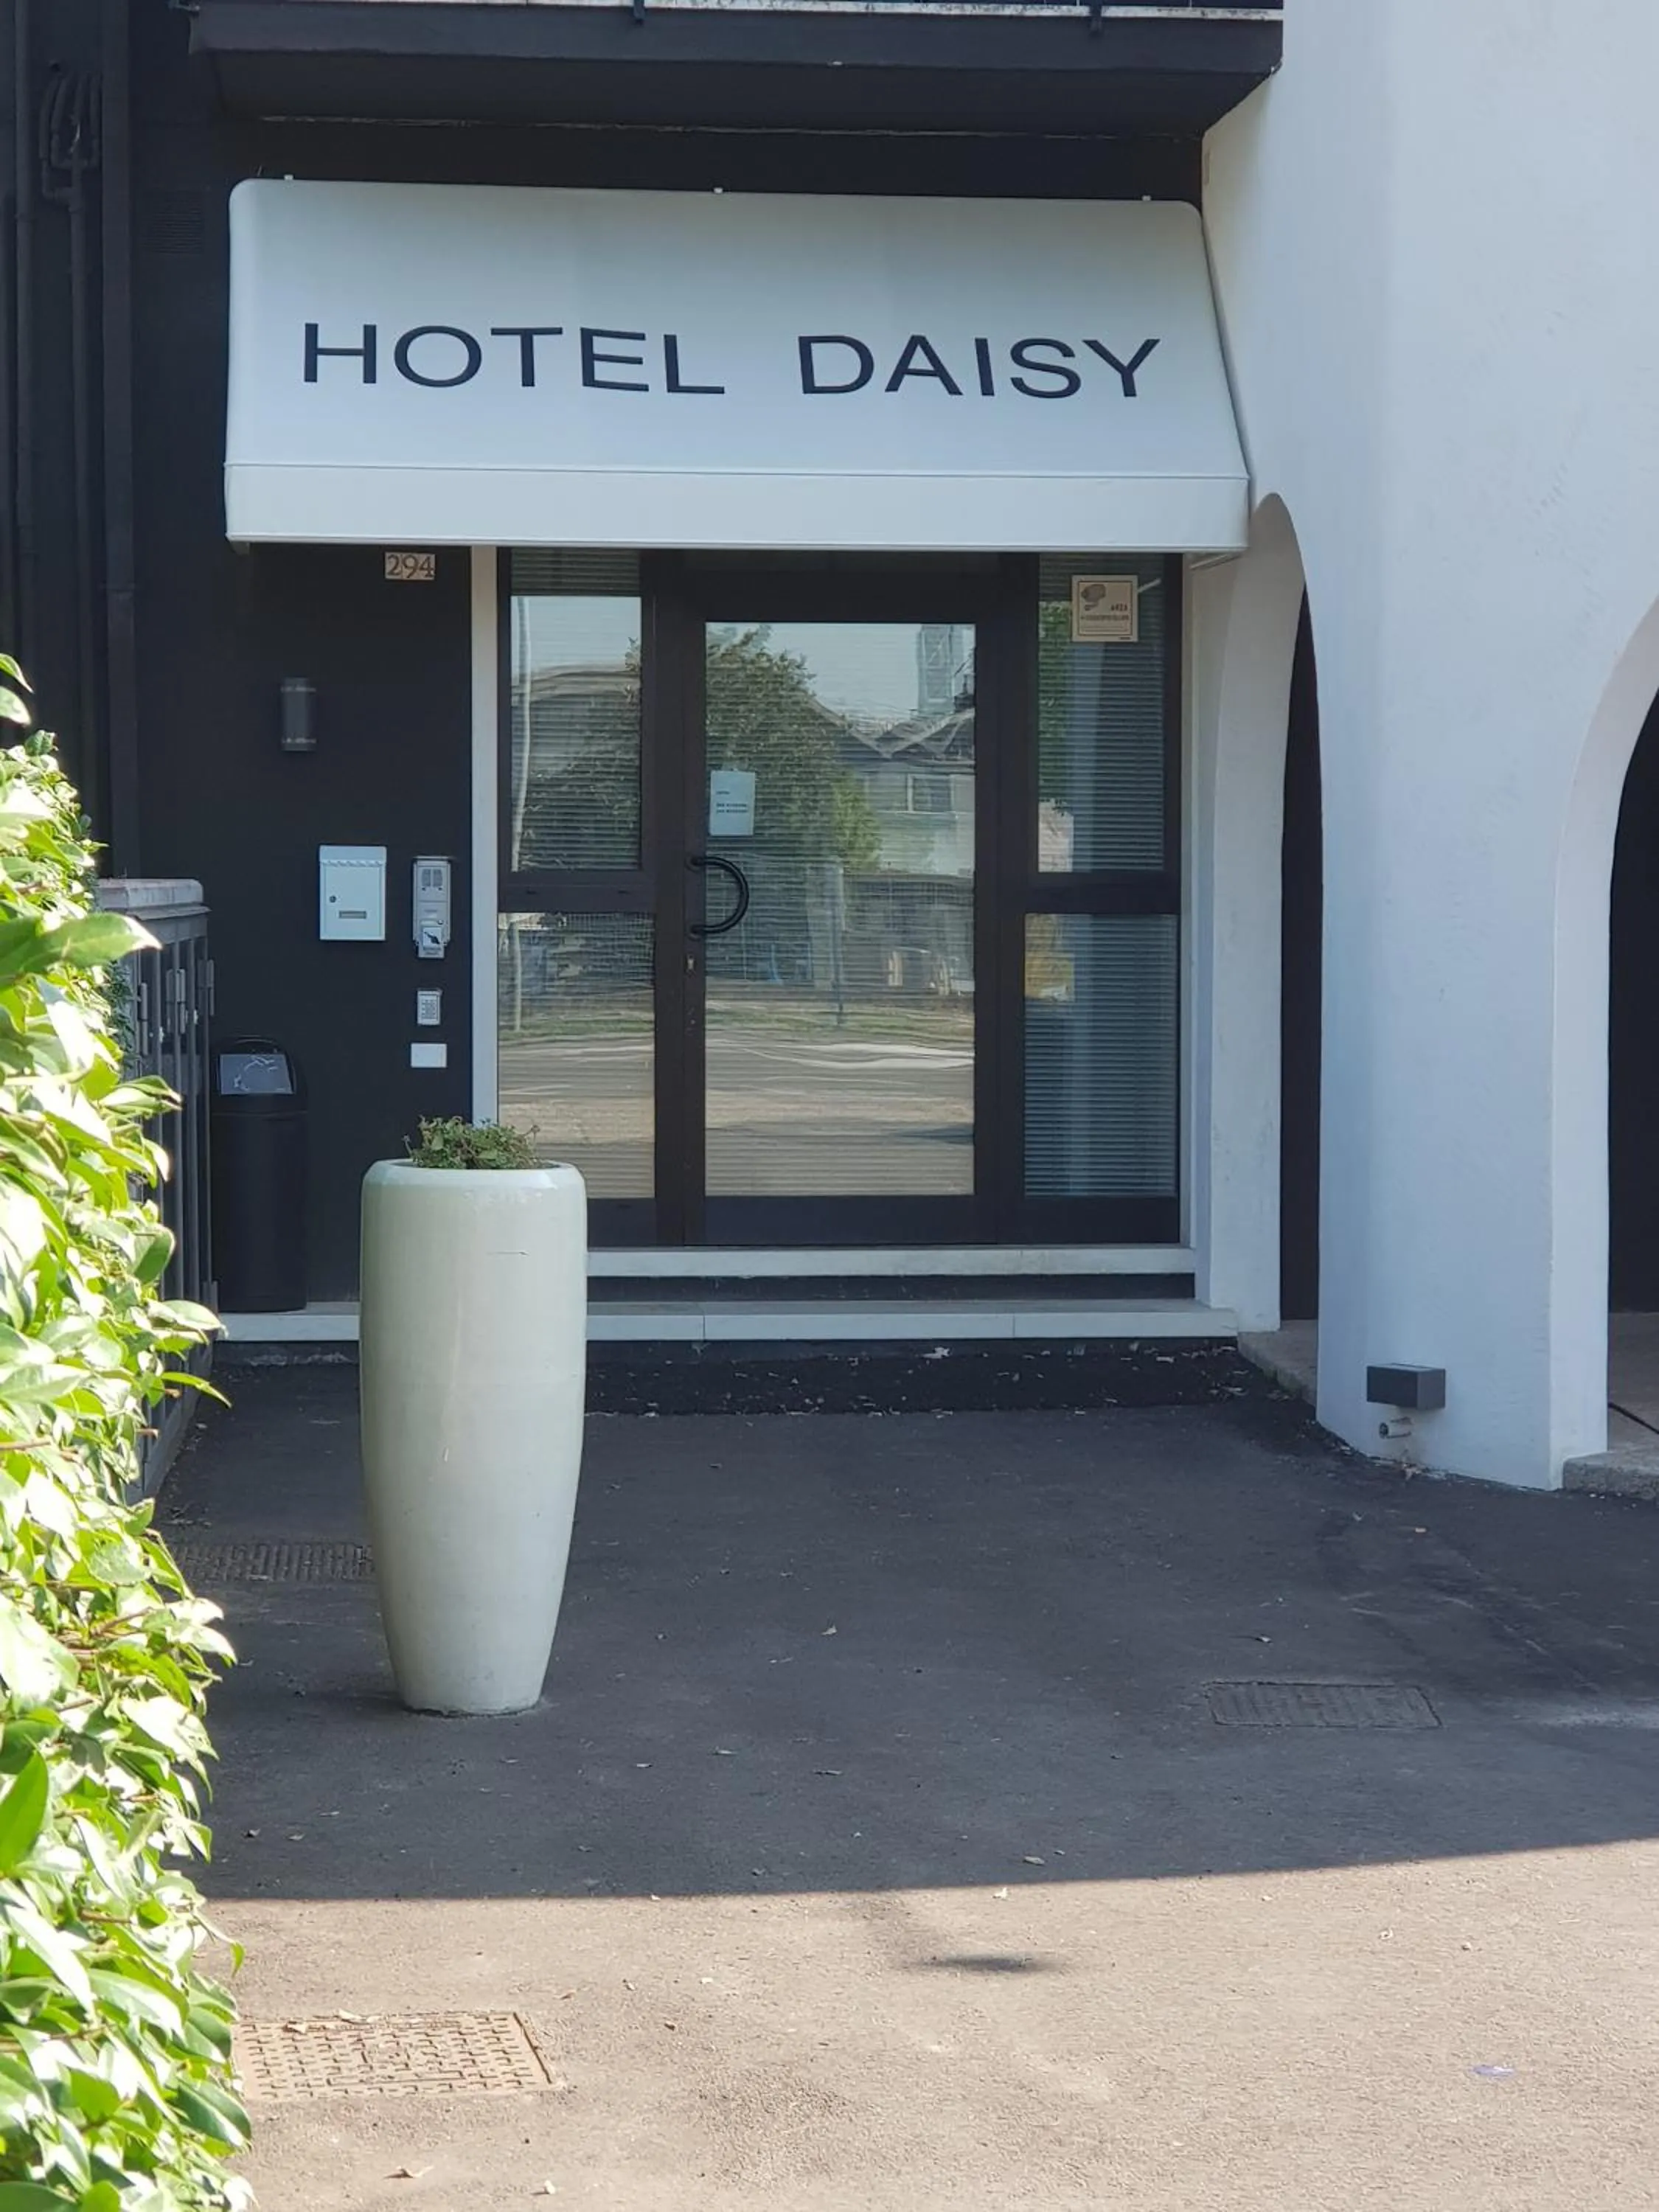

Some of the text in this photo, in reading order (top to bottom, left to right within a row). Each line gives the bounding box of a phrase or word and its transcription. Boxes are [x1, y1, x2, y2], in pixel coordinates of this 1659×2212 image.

[304, 322, 1161, 399] HOTEL DAISY
[387, 554, 434, 578] 294
